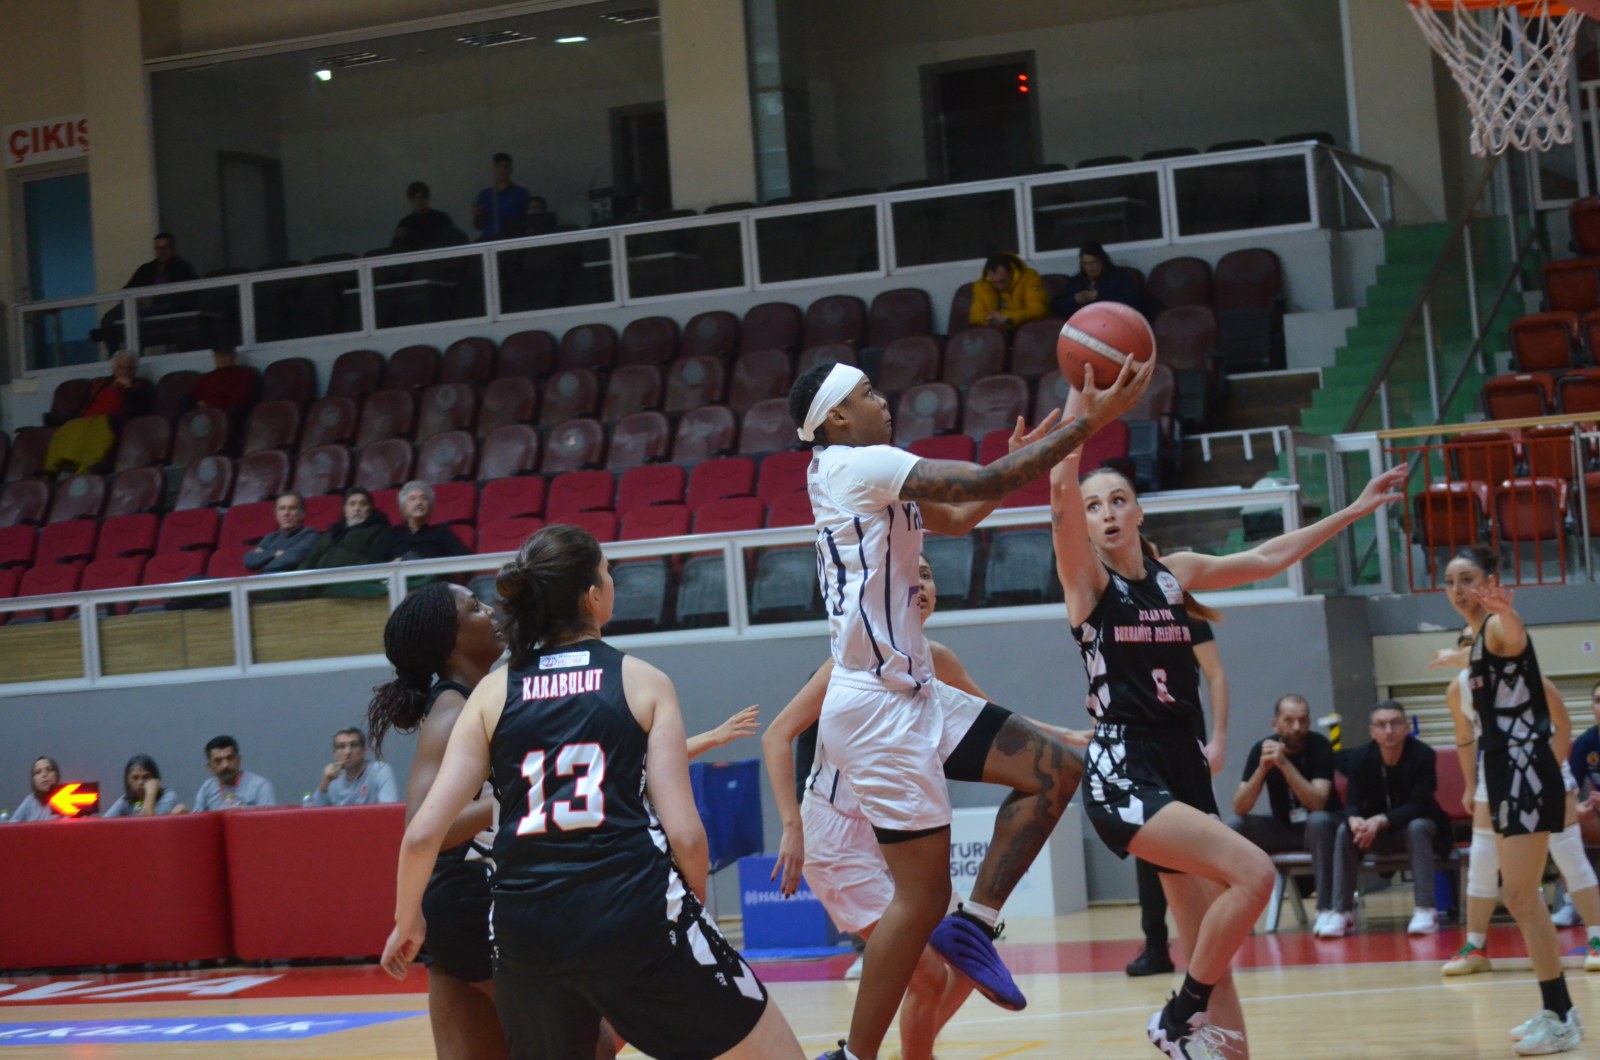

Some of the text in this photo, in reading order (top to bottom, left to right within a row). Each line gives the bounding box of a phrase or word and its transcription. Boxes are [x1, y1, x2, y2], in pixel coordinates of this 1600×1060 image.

[9, 118, 89, 164] ÇIKIŞ
[522, 668, 603, 701] KARABULUT
[516, 741, 606, 836] 13
